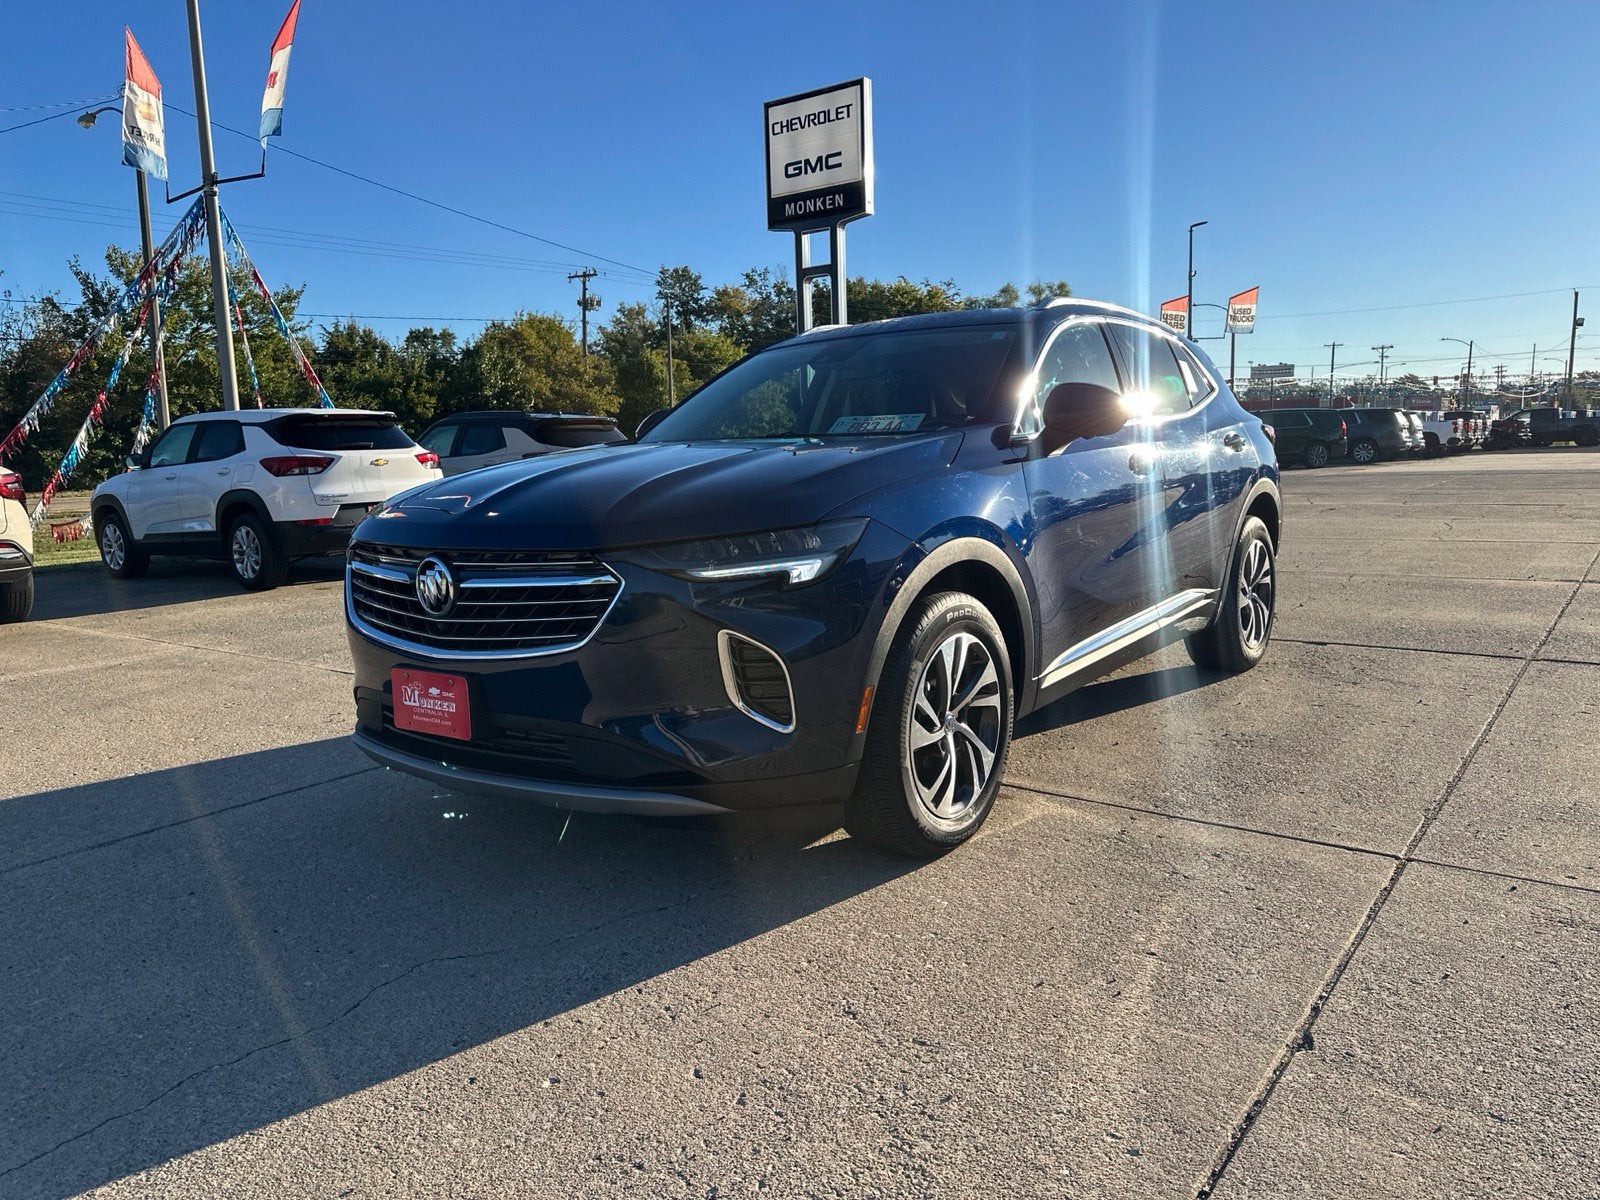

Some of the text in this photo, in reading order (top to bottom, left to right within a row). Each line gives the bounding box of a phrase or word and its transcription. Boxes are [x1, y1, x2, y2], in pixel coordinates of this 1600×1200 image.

[771, 103, 853, 136] CHEVROLET
[784, 151, 842, 179] GMC
[785, 193, 844, 217] MONKEN
[1162, 312, 1186, 322] USED
[1229, 314, 1256, 323] TRUCKS
[1232, 307, 1252, 316] USED
